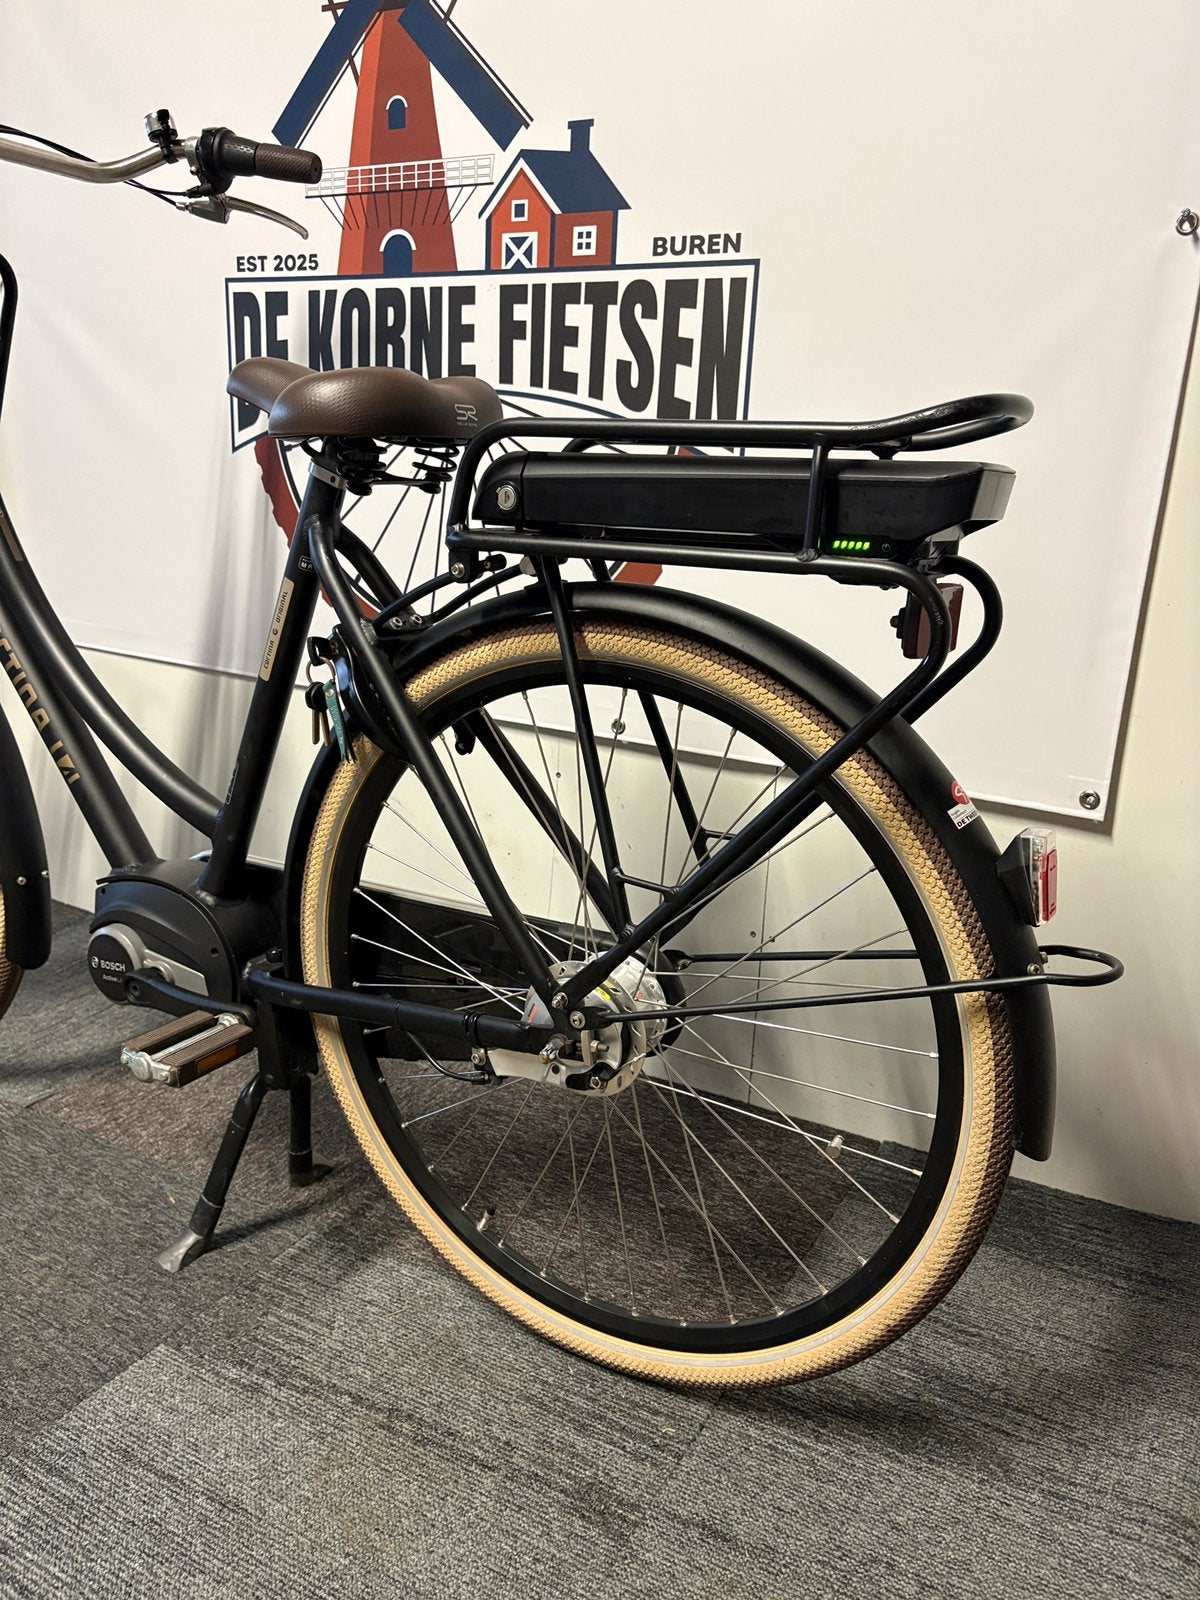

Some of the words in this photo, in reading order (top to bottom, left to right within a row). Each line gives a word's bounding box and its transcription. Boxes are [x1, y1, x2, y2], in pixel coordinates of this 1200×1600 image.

[653, 233, 741, 256] BUREN
[237, 256, 267, 272] EST
[274, 254, 318, 271] 2025
[308, 286, 477, 380] KORNE
[499, 277, 747, 420] FIETSEN
[100, 960, 126, 972] BOSCH
